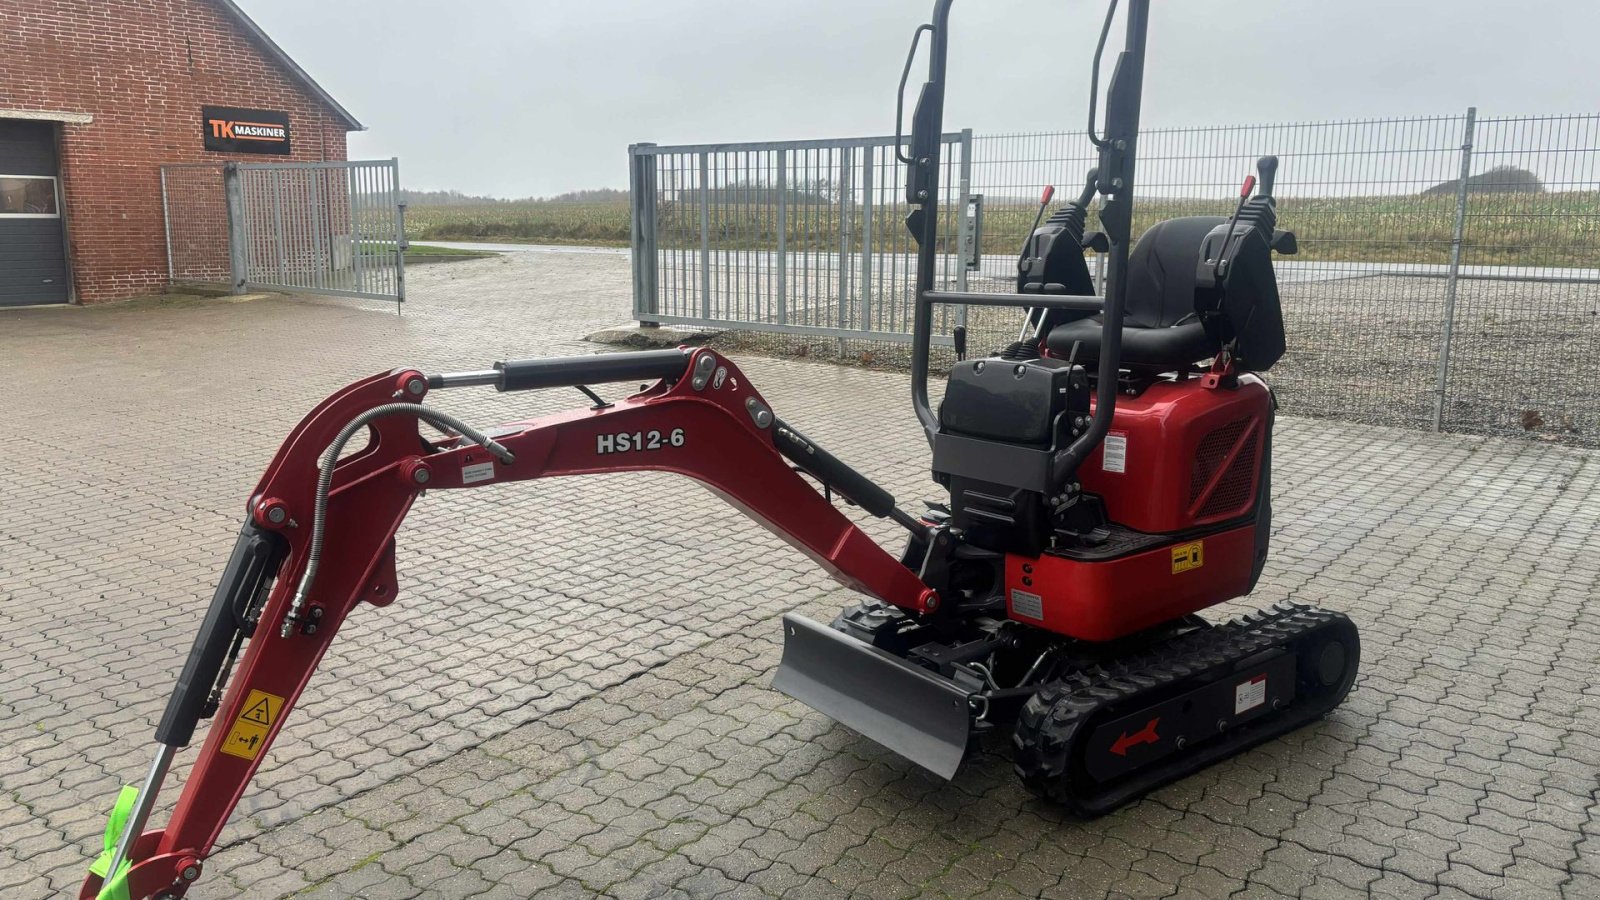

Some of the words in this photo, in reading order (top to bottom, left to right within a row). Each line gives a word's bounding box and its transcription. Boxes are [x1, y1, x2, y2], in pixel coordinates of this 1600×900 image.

[209, 119, 236, 138] TK
[235, 126, 286, 137] MASKINER
[597, 428, 684, 454] HS12-6
